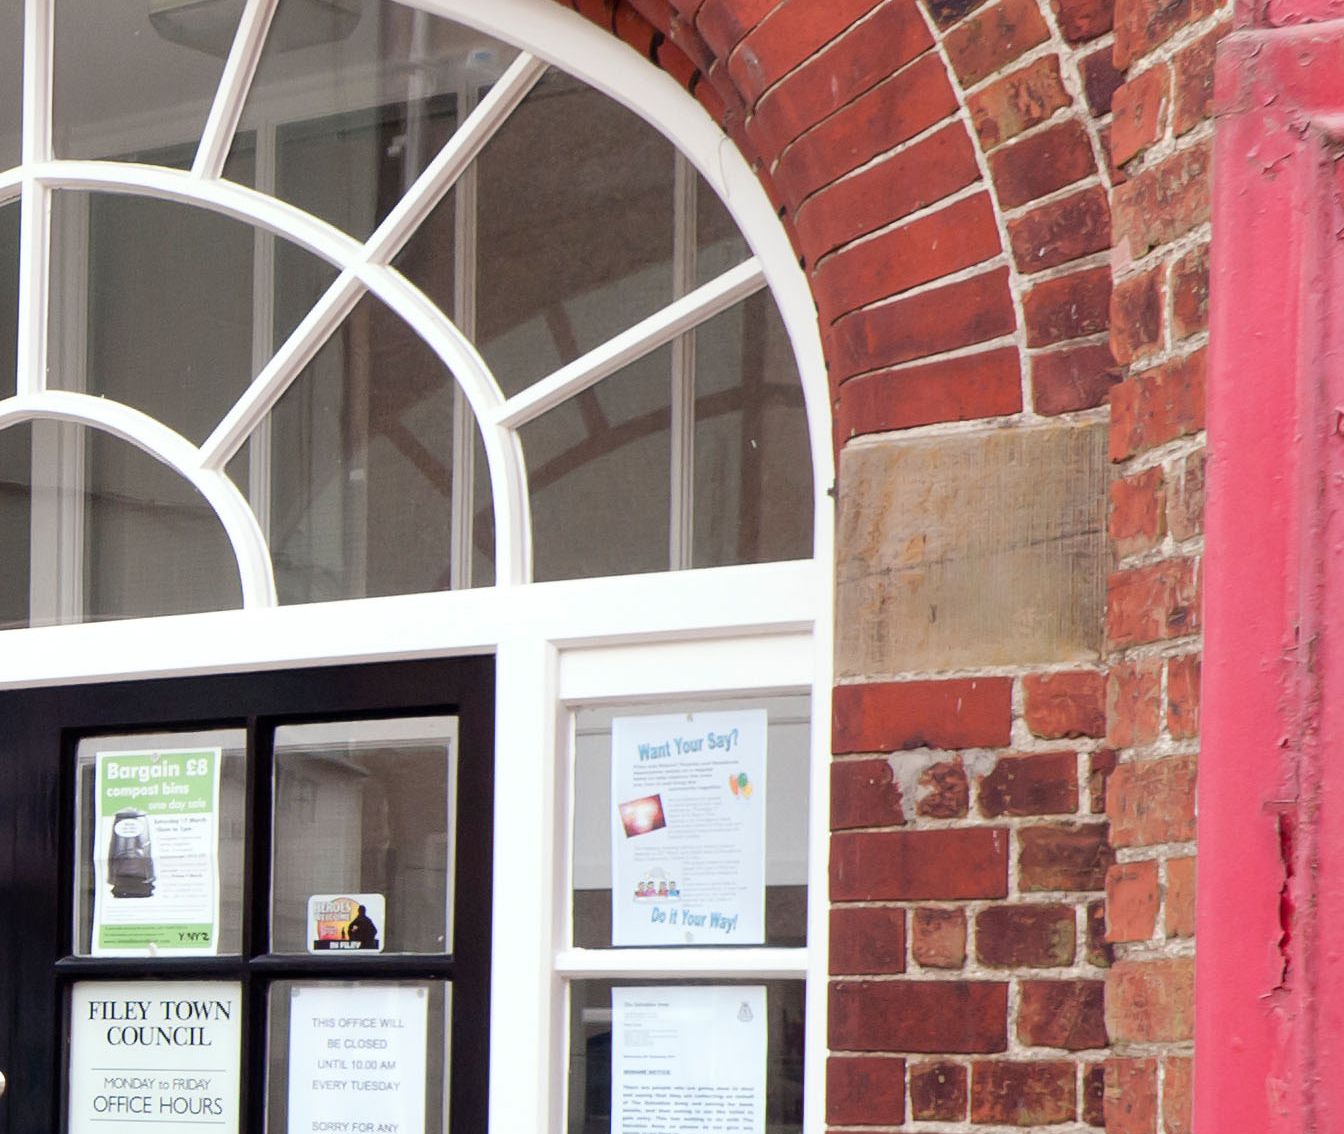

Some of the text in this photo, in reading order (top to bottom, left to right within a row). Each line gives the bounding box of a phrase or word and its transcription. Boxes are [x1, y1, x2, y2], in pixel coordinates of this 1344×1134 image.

[638, 728, 738, 761] Want Your Say?
[106, 758, 209, 783] Bargain £8
[106, 782, 189, 799] compost bins
[168, 799, 185, 812] day
[651, 907, 666, 923] Do
[681, 909, 707, 927] Your
[710, 913, 738, 933] Way!
[88, 1001, 232, 1021] FILEY TOWN
[312, 1018, 404, 1028] THIS OFFICE WILL
[107, 1026, 212, 1046] COUNCIL
[327, 1038, 387, 1049] BE CLOSED
[318, 1060, 396, 1070] UNTIL 10.00 AM
[104, 1077, 211, 1090] MONDAY to FRIDAY
[312, 1080, 400, 1091] EVERY TUESDAY
[93, 1095, 223, 1115] OFFICE HOURS
[311, 1121, 399, 1133] SORRY FOR ANY
